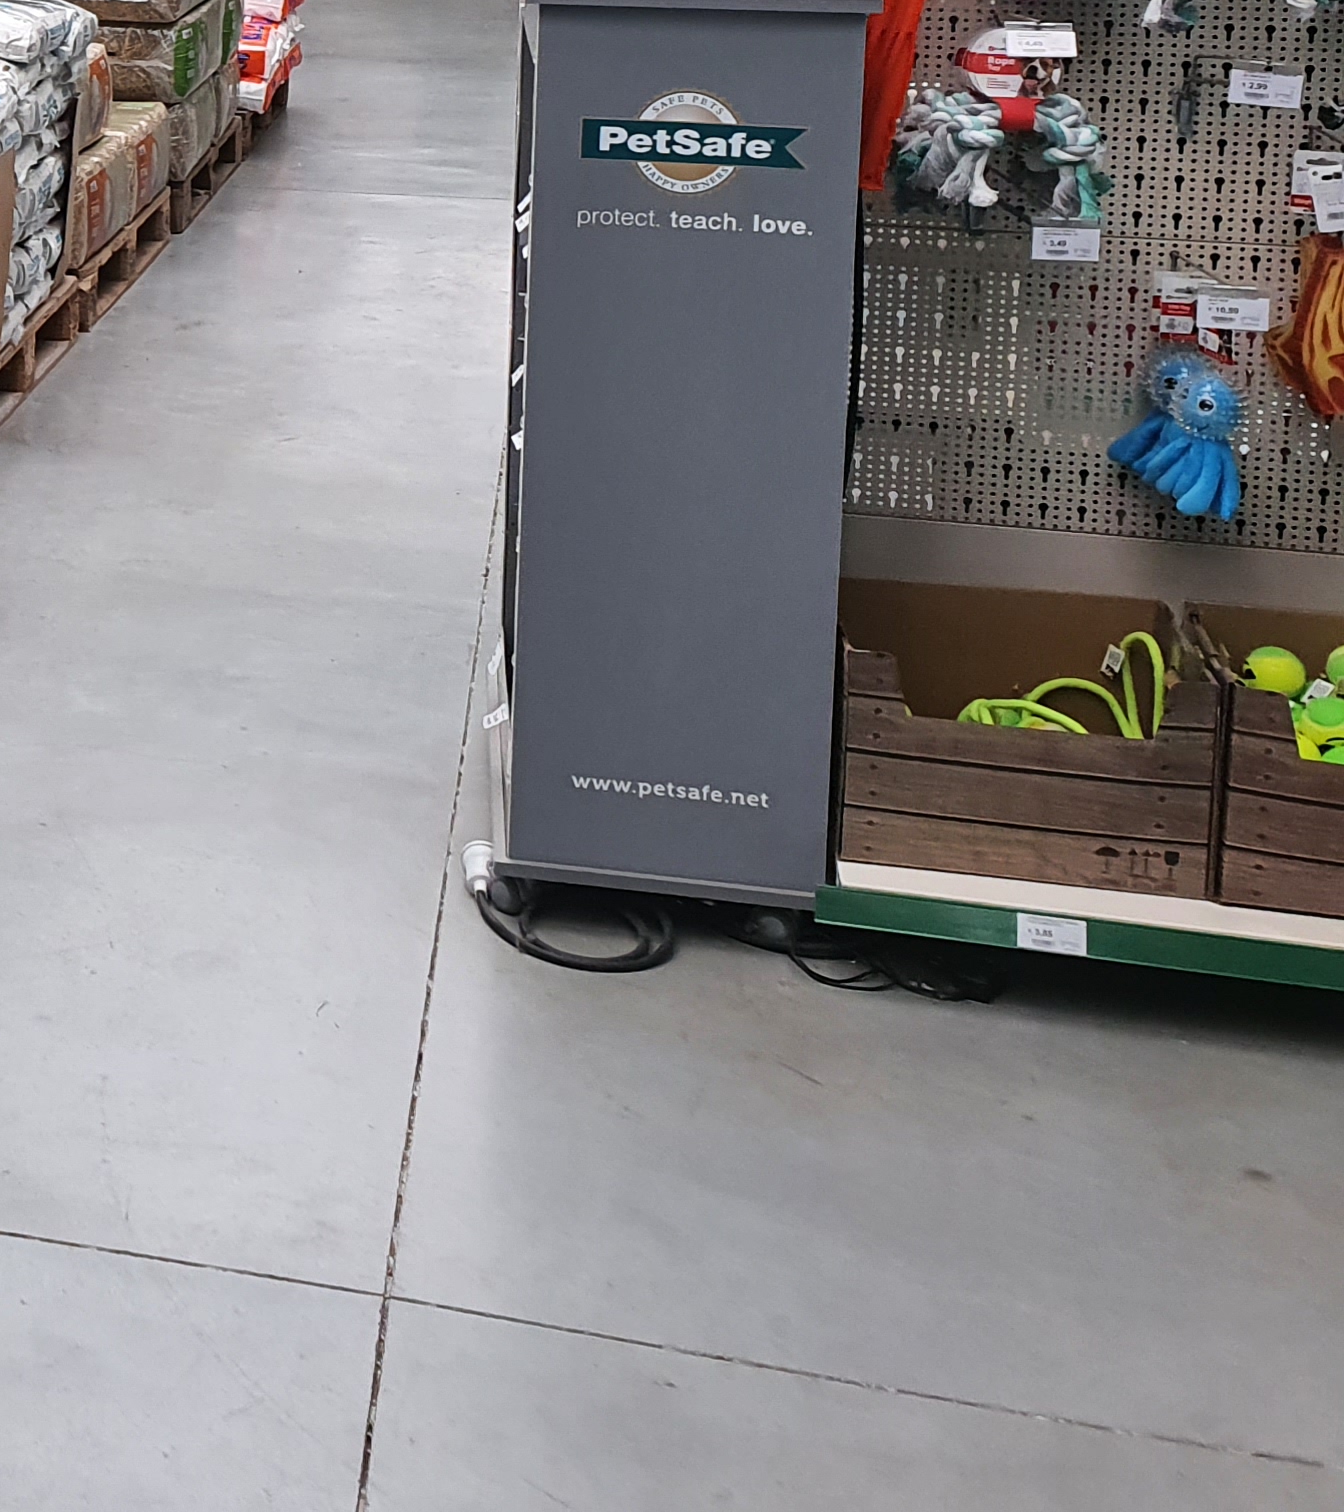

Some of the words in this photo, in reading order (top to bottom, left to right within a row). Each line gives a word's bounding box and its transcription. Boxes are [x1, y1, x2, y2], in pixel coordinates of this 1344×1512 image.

[652, 94, 685, 114] SAFE
[692, 95, 724, 115] PETS
[599, 126, 772, 159] PetSafe
[642, 164, 677, 190] HAPPY
[681, 166, 730, 191] OWNERS
[576, 208, 660, 228] protect.
[670, 210, 743, 232] teach.
[753, 214, 813, 236] love.
[571, 770, 770, 810] www.petsafe.net
